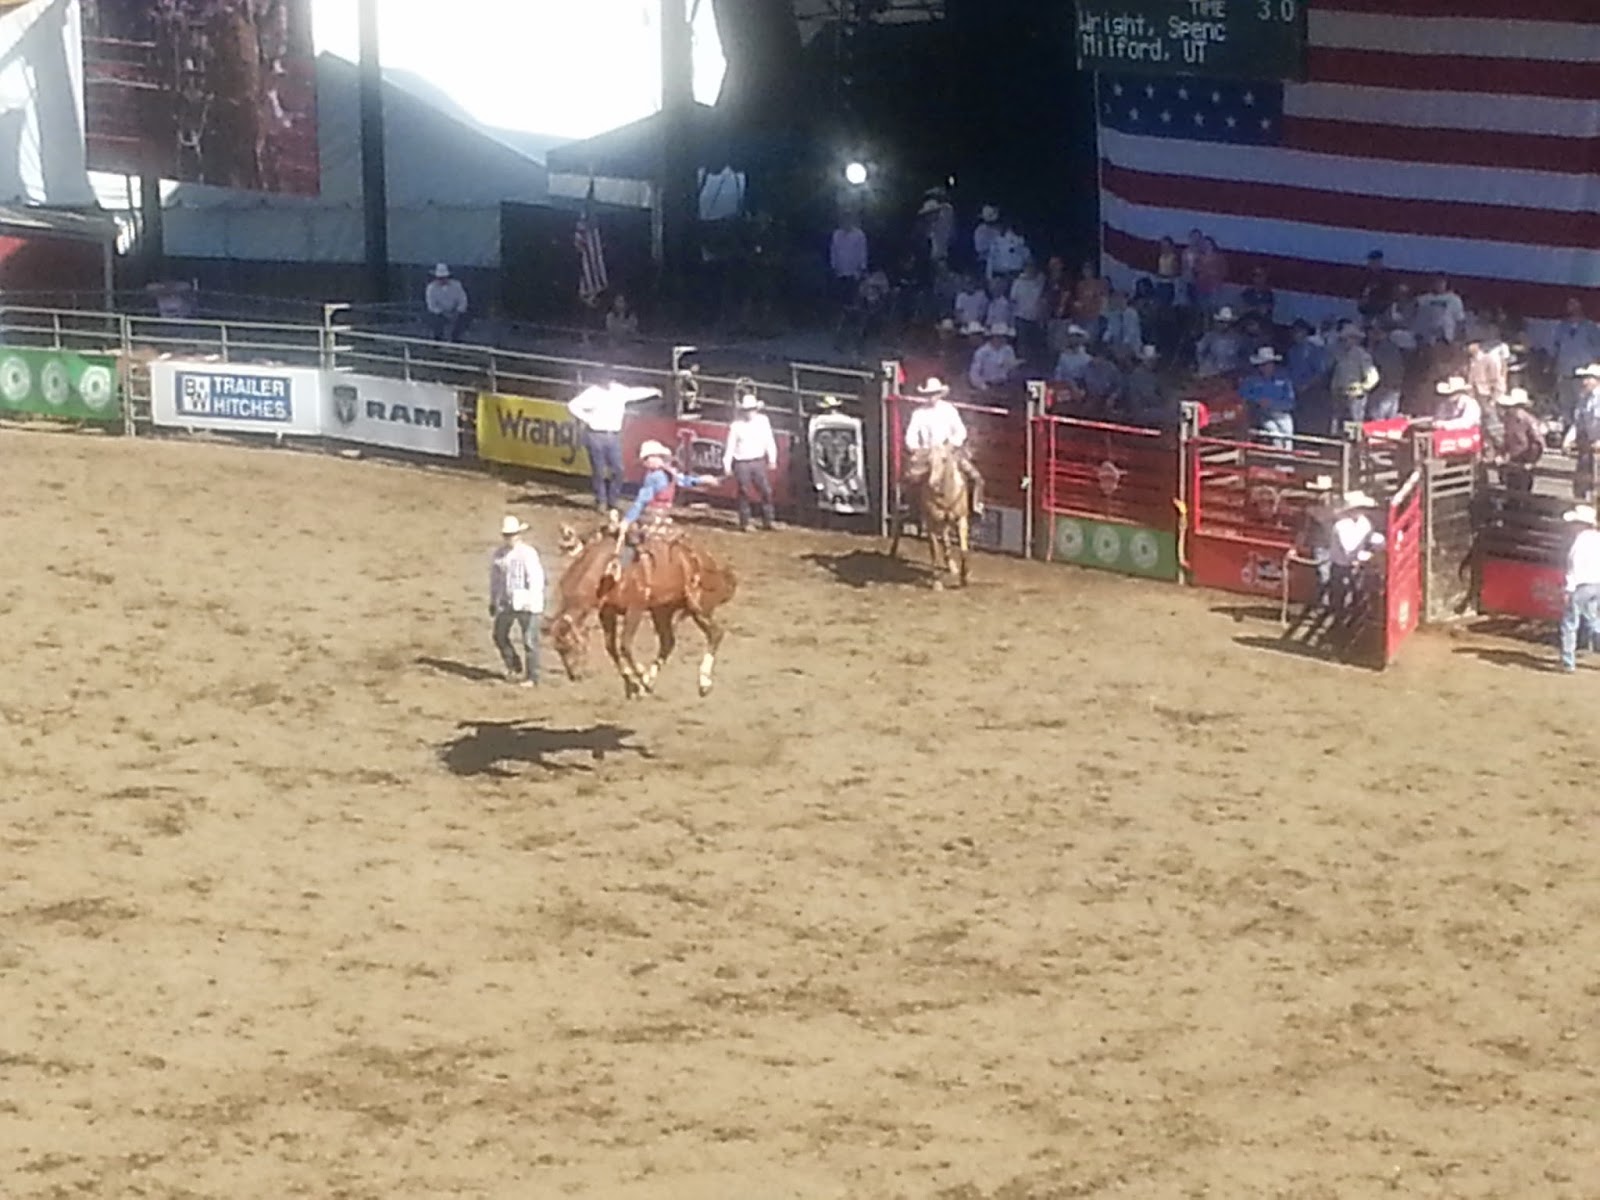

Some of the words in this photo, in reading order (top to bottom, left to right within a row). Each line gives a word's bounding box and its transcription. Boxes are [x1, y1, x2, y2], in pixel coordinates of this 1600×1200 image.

[1257, 0, 1295, 21] 3.0
[1168, 15, 1226, 41] Spenc
[1183, 40, 1207, 63] UT
[213, 377, 285, 397] TRAILER
[213, 397, 287, 418] HITCHES
[366, 400, 442, 428] RAM
